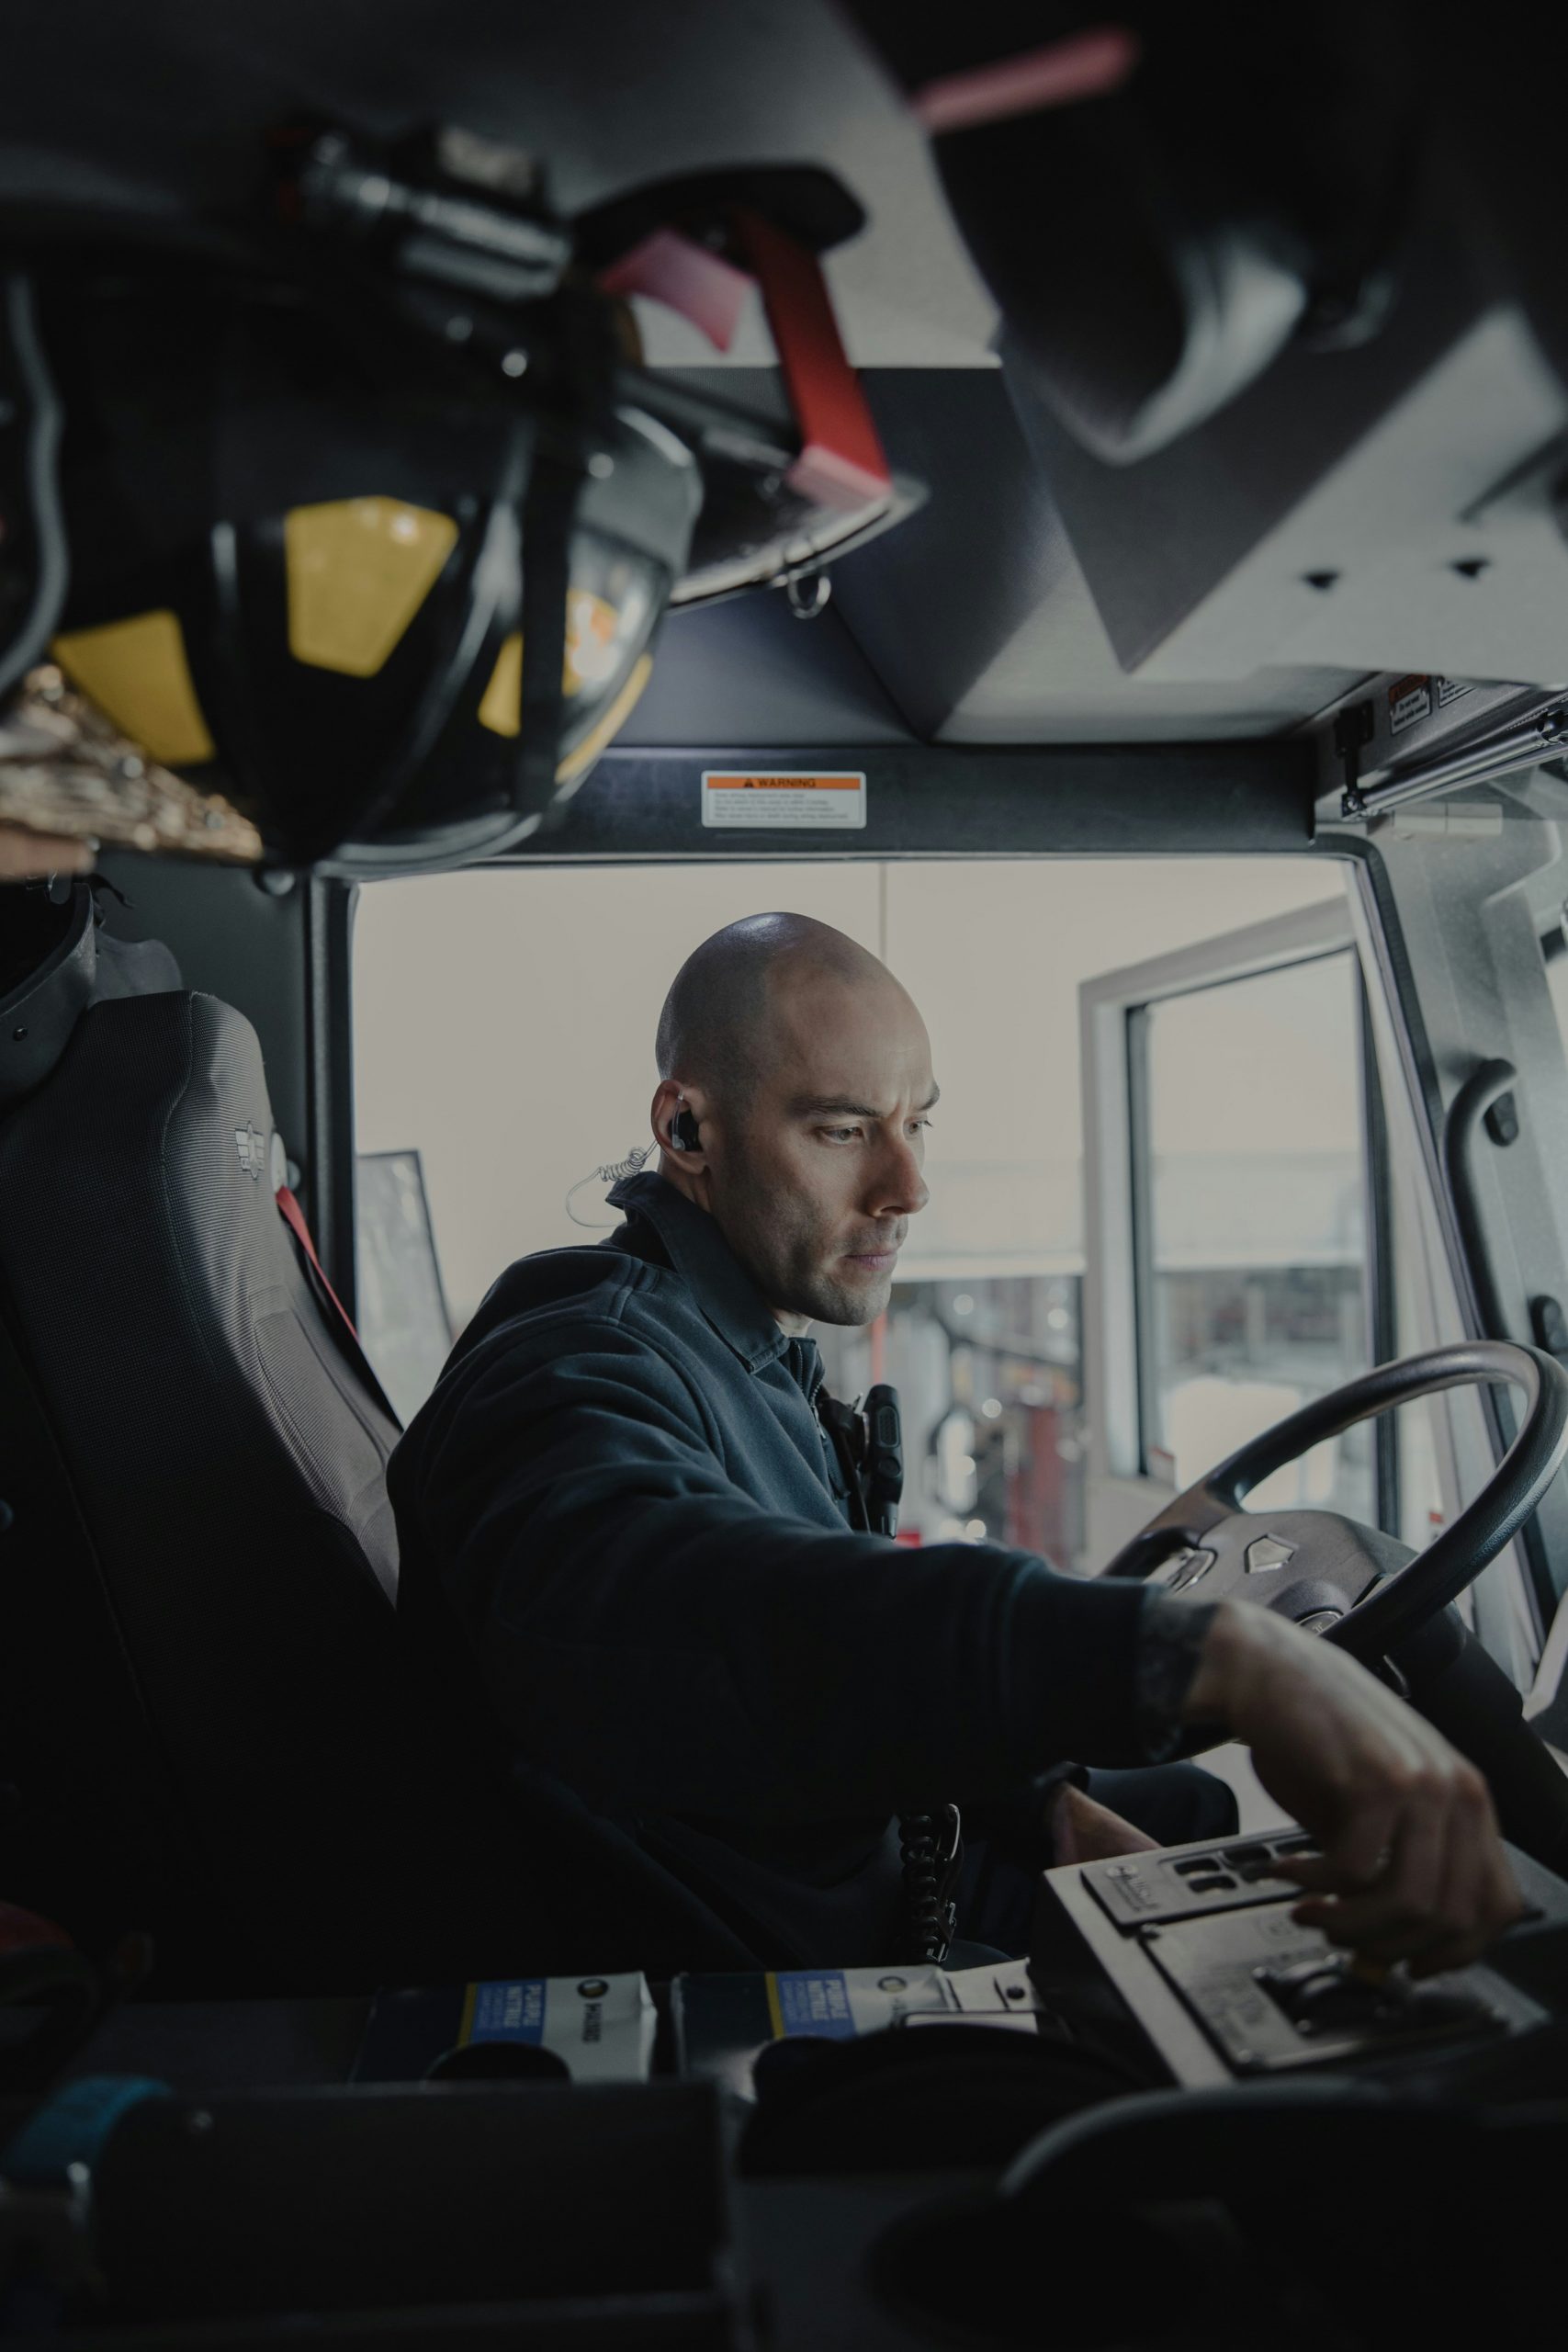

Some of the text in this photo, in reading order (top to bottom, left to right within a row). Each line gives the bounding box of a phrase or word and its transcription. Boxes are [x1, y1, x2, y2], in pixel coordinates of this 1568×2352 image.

[758, 778, 817, 787] WARNING
[807, 1980, 829, 2020] NITRILE
[826, 1979, 850, 2019] PURPLE
